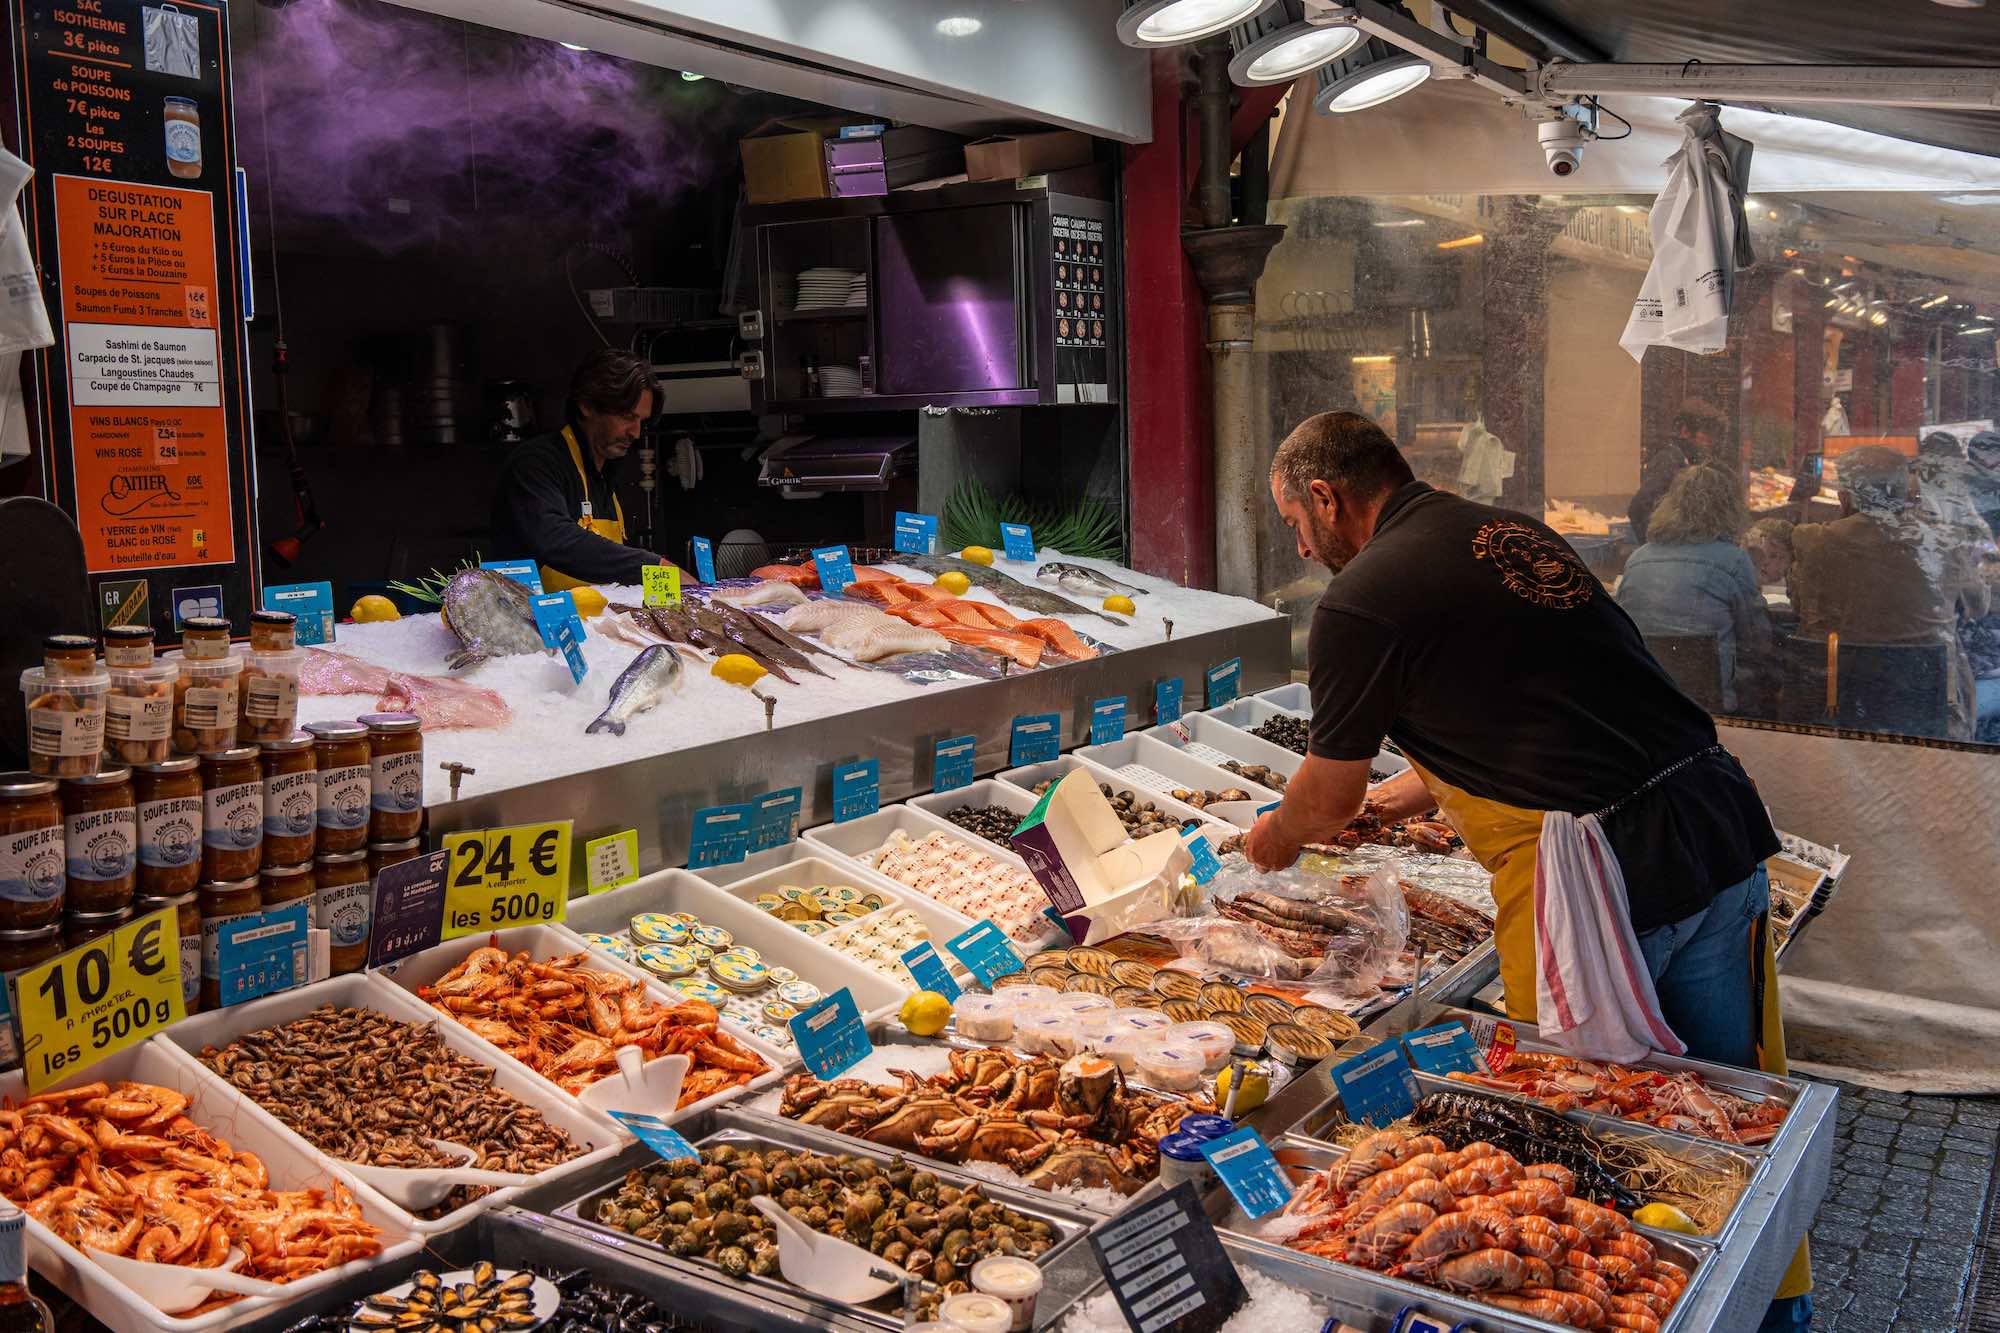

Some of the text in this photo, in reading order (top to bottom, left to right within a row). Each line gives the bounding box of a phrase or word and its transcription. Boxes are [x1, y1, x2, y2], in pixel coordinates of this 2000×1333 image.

[77, 0, 101, 12] SAC
[54, 10, 127, 34] ISOTHERME
[63, 32, 120, 55] 3€ pièce
[71, 65, 112, 83] SOUPE
[53, 79, 130, 101] de POISSONS
[67, 99, 120, 120] 7€ pièce
[86, 123, 104, 135] Les
[67, 136, 124, 153] 2 SOUPES
[82, 156, 112, 173] 12€
[88, 188, 182, 210] DEGUSTATION
[99, 206, 174, 226] SUR PLACE
[93, 222, 181, 242] MAJORATION
[102, 242, 108, 251] 5
[138, 245, 150, 254] du
[152, 247, 170, 256] Kilo
[172, 250, 183, 258] ou
[101, 254, 107, 262] 5
[137, 256, 145, 265] la
[174, 261, 185, 269] ou
[100, 264, 106, 273] 5
[137, 267, 145, 276] la
[147, 268, 188, 279] Douzaine
[74, 286, 107, 298] Soupes
[109, 288, 120, 297] de
[122, 289, 160, 300] Poissons
[75, 303, 111, 314] Saumon
[139, 305, 145, 315] 3
[146, 306, 183, 317] Tranches
[105, 340, 186, 352] Sashimi de Saumon
[78, 353, 116, 365] Carpacio
[118, 354, 129, 363] de
[101, 368, 195, 380] Langoustines Chaudes
[90, 381, 204, 394] Coupe de Champagne 7€
[90, 416, 111, 426] VINS
[113, 416, 149, 426] BLANCS
[95, 448, 116, 458] VINS
[107, 526, 137, 536] VERRE
[139, 526, 149, 534] de
[151, 525, 165, 534] VIN
[107, 537, 137, 548] BLANC
[140, 537, 150, 545] ou
[117, 552, 152, 564] bouteille
[154, 551, 176, 561] d'eau
[105, 590, 120, 605] GR
[382, 756, 404, 773] SOUPE
[405, 754, 412, 765] DE
[271, 776, 294, 795] SOUPE
[296, 774, 304, 786] DE
[324, 770, 347, 788] SOUPE
[349, 768, 356, 779] DE
[216, 789, 240, 807] SOUPE
[241, 785, 249, 797] DE
[282, 791, 300, 808] Chez
[334, 785, 352, 800] Chez
[143, 802, 169, 822] SOUPE
[170, 800, 181, 813] DE
[227, 804, 245, 820] Chez
[75, 815, 101, 834] SOUPE
[102, 812, 113, 824] DE
[155, 820, 176, 836] Chez
[12, 830, 50, 855] SOUPE DE
[87, 831, 109, 849] Chez
[25, 851, 47, 869] Chez
[454, 835, 515, 888] 24
[529, 829, 560, 877] €
[493, 876, 528, 889] emporter
[322, 887, 354, 907] SOUPE DE
[451, 909, 481, 930] les
[39, 919, 166, 1022] 10 €
[81, 990, 136, 1024] EMPORTER
[43, 1043, 81, 1075] les
